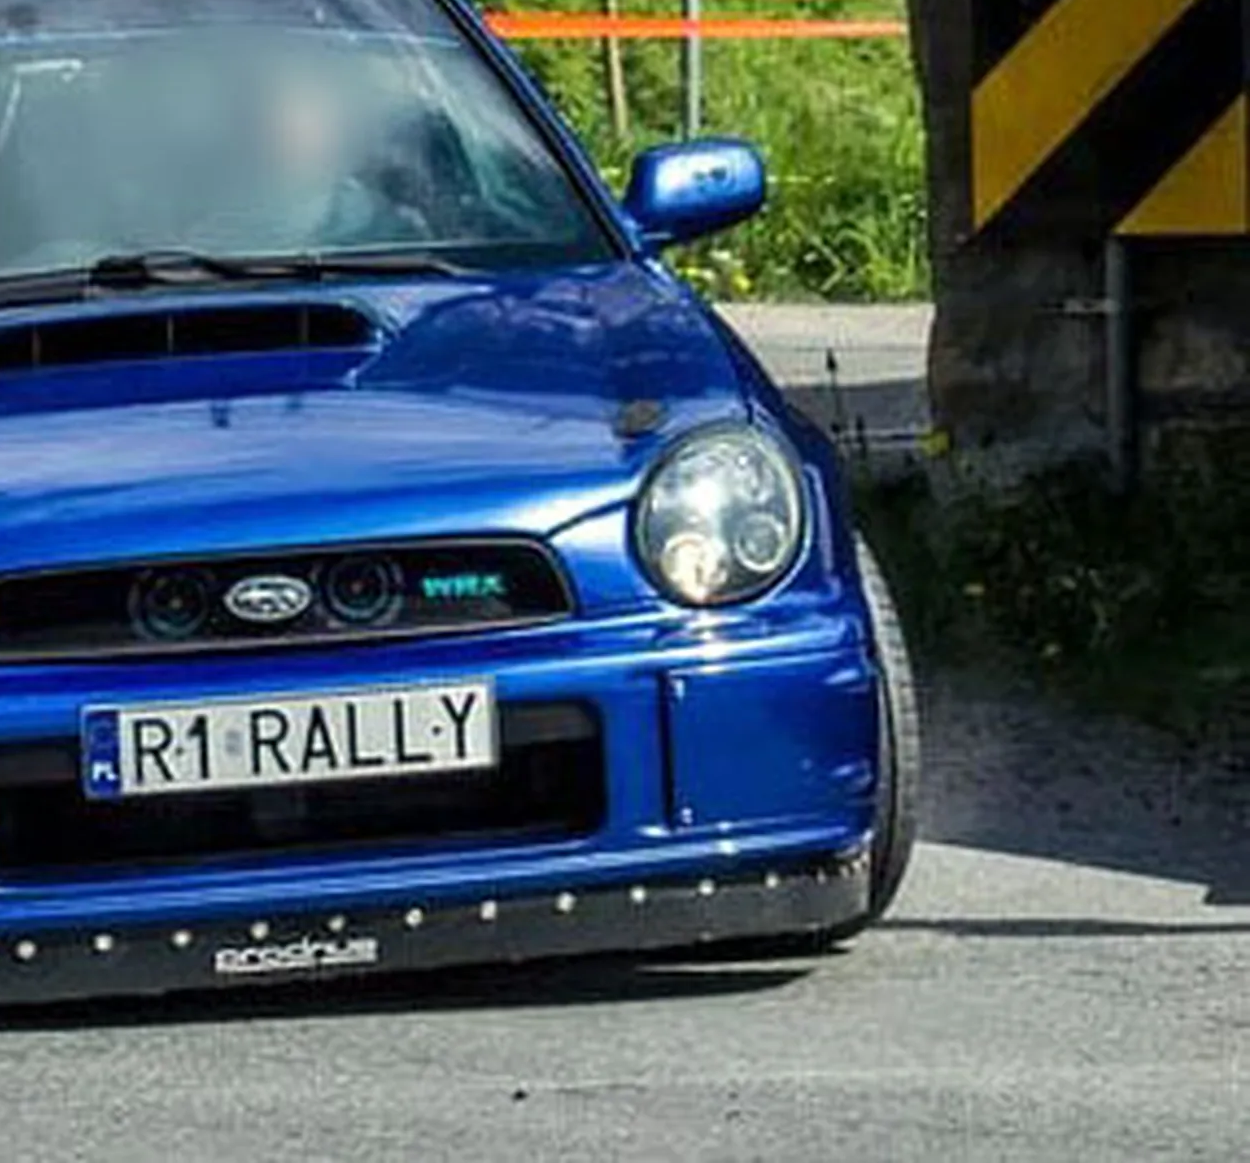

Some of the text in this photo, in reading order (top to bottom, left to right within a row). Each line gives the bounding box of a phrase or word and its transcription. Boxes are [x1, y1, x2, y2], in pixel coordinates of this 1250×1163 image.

[422, 572, 507, 598] WRX
[132, 692, 477, 783] R1 RALLY
